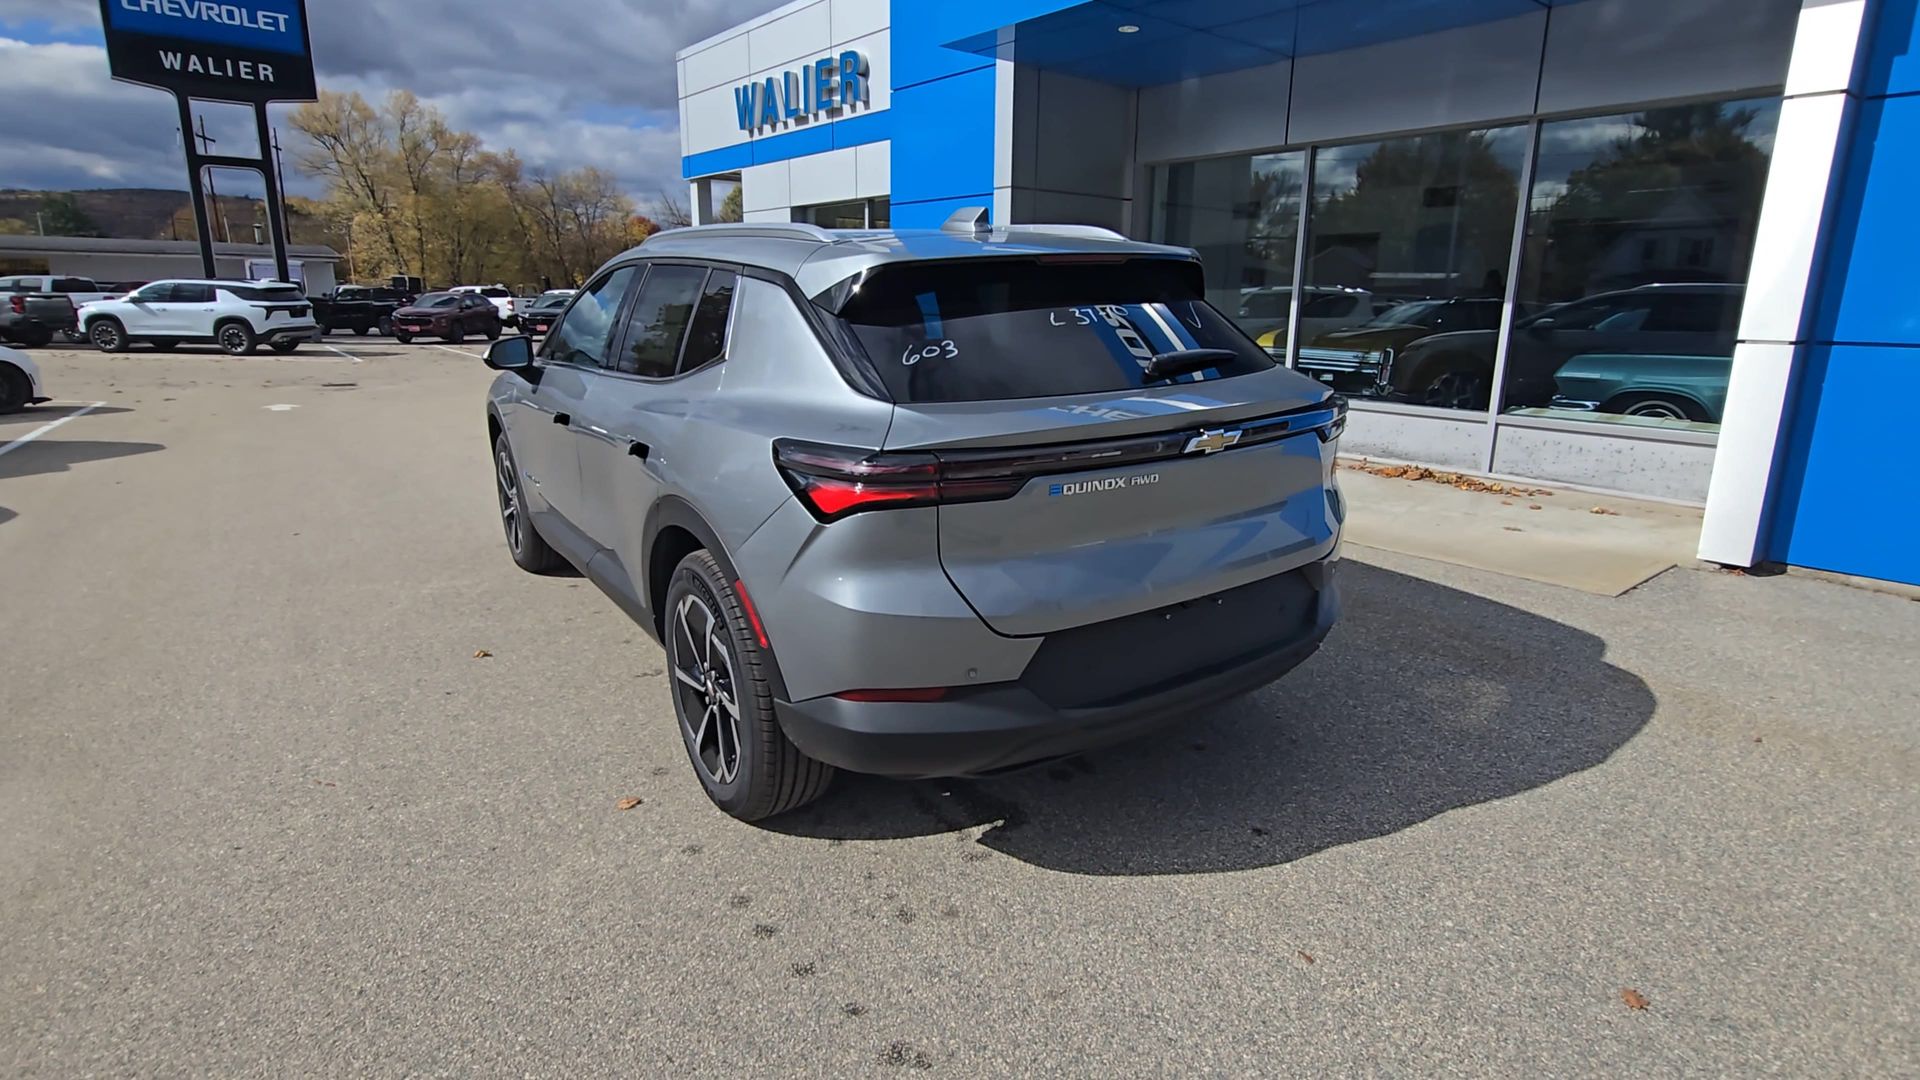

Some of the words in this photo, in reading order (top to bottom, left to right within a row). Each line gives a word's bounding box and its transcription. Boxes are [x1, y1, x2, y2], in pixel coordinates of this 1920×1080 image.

[121, 0, 289, 33] CHEVROLET
[158, 50, 275, 83] WALIER
[734, 49, 869, 132] WALIER
[902, 340, 959, 366] 603
[1049, 477, 1126, 496] EQUINOX
[1131, 473, 1159, 486] AWD
